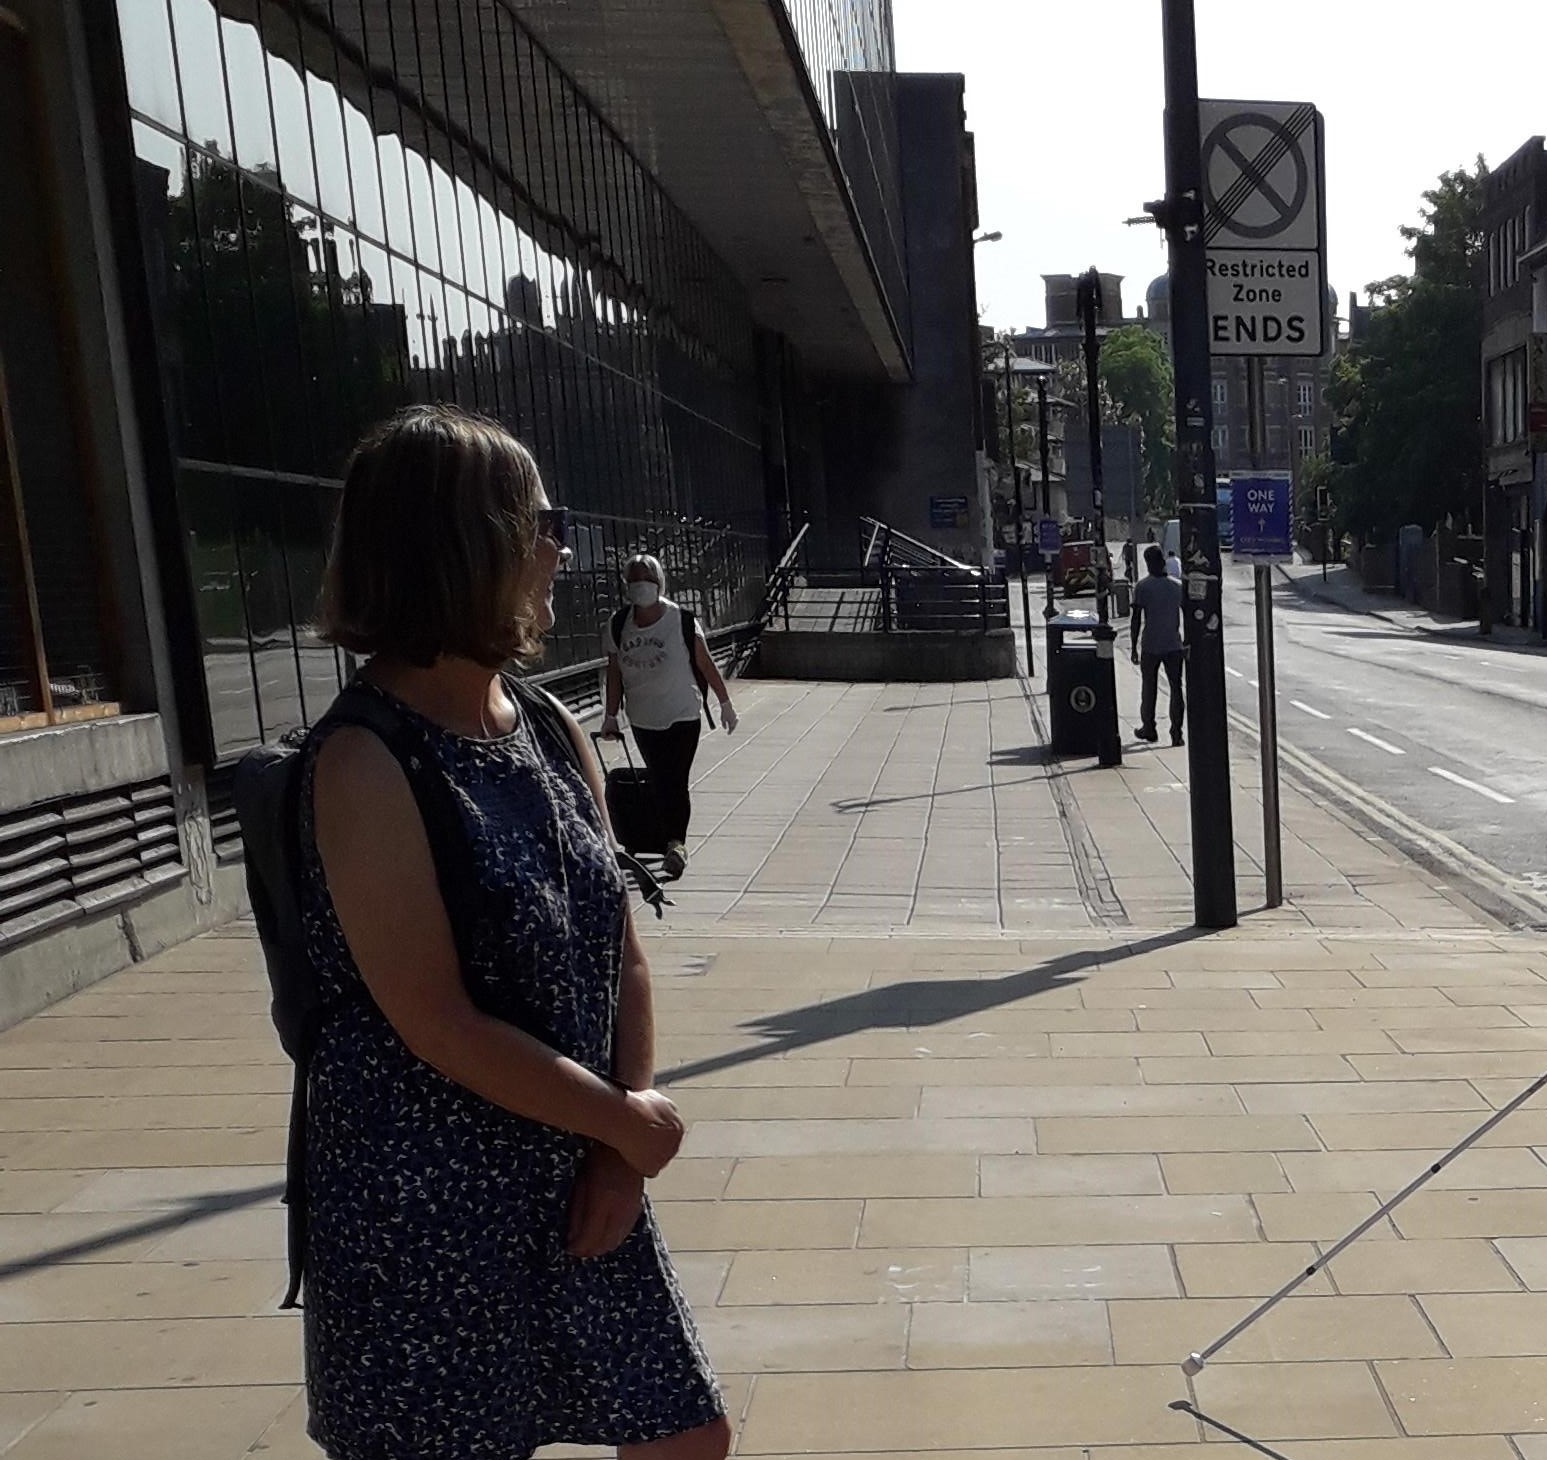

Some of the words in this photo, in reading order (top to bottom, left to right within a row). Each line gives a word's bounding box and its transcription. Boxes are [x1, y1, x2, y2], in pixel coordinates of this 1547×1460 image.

[1206, 259, 1309, 278] Restricted
[1232, 284, 1282, 303] Zone
[1213, 315, 1305, 343] ENDS
[1247, 489, 1275, 501] ONE
[1247, 502, 1275, 513] WAY
